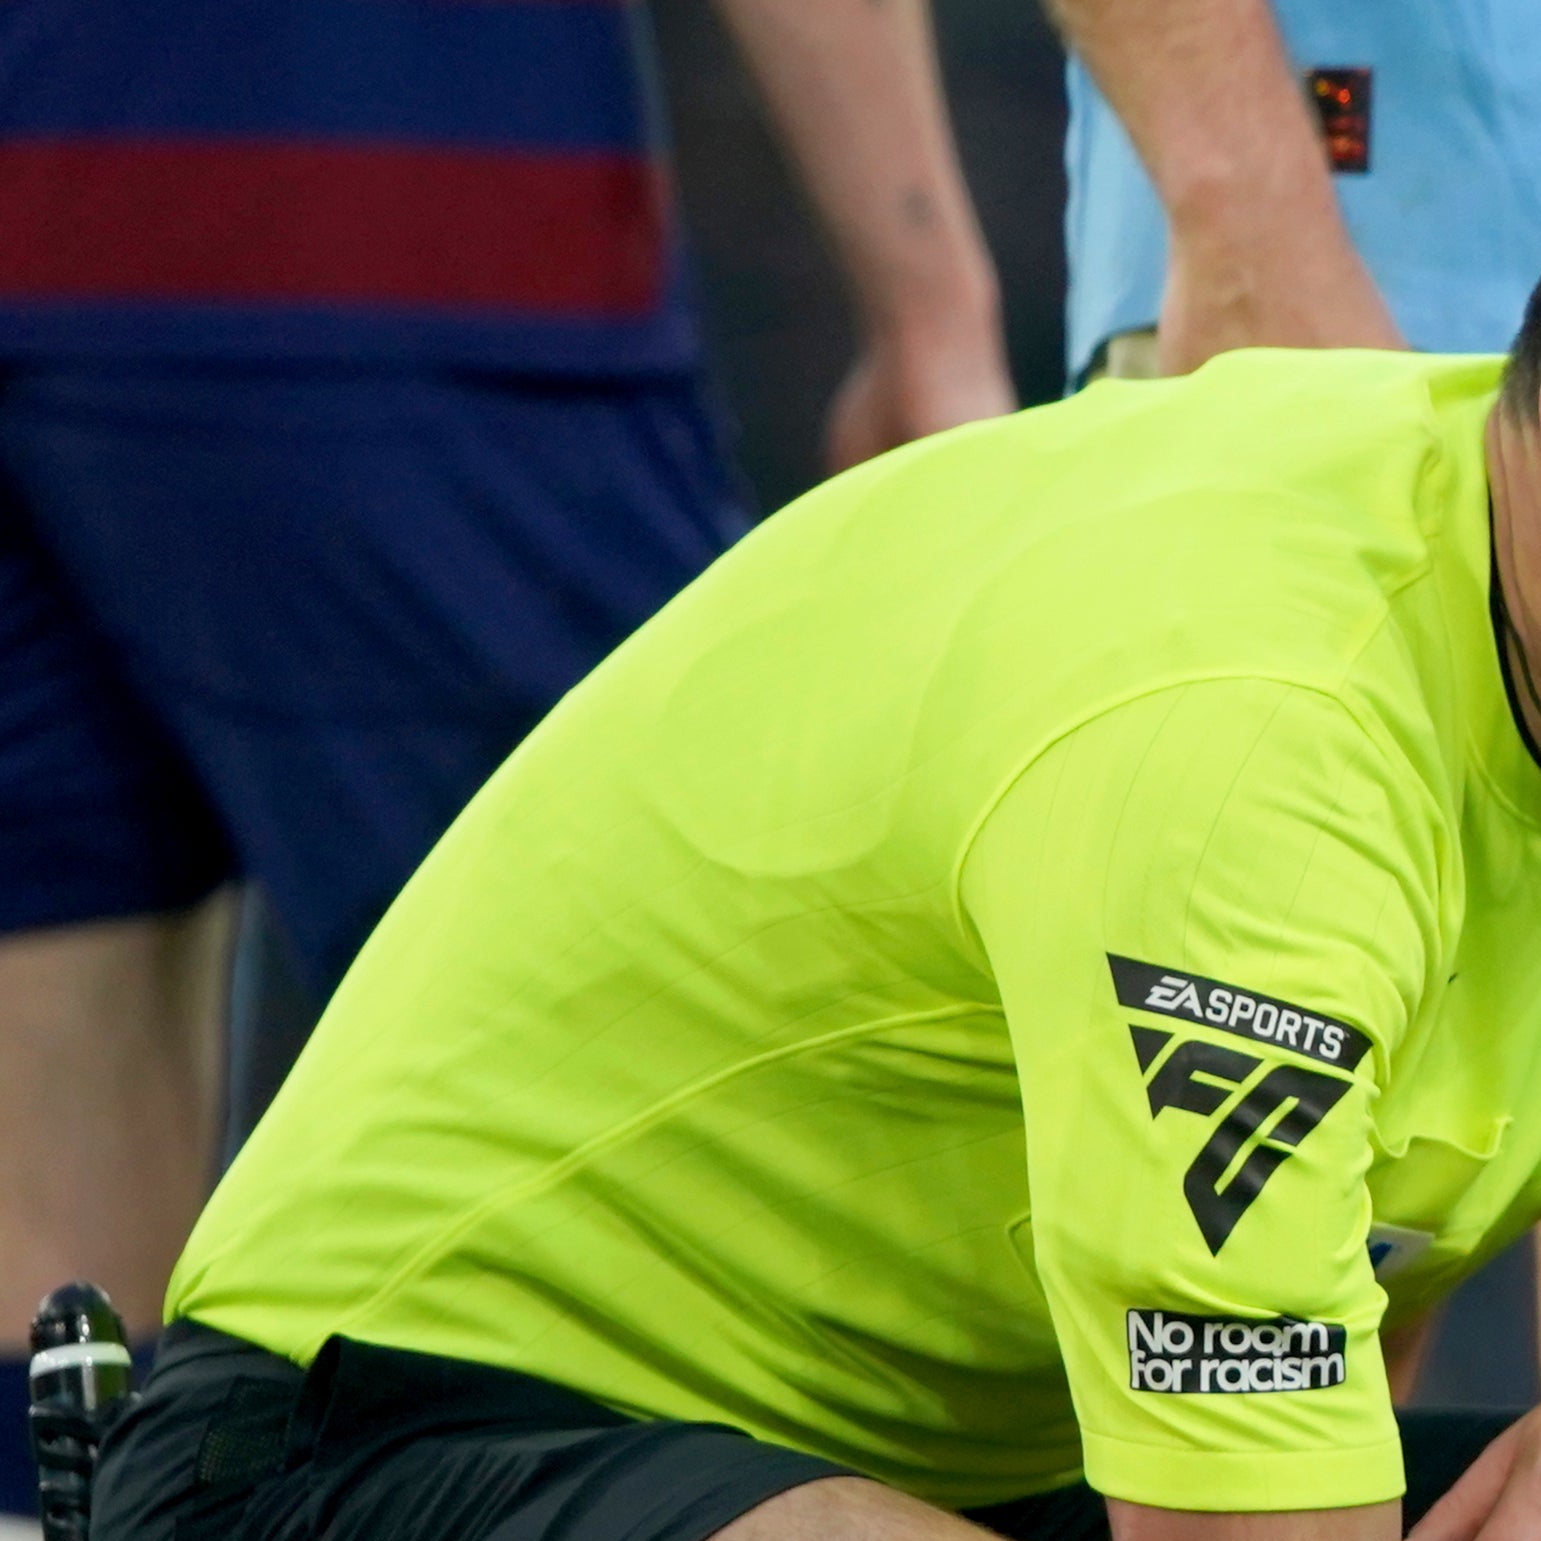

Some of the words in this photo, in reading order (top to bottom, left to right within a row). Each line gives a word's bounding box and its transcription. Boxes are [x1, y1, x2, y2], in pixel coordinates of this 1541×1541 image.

[1144, 975, 1204, 1018] EA
[1205, 992, 1347, 1060] SPORTS
[1129, 1310, 1194, 1355] No
[1204, 1321, 1329, 1357] room
[1131, 1350, 1192, 1392] for
[1200, 1353, 1346, 1391] racism
